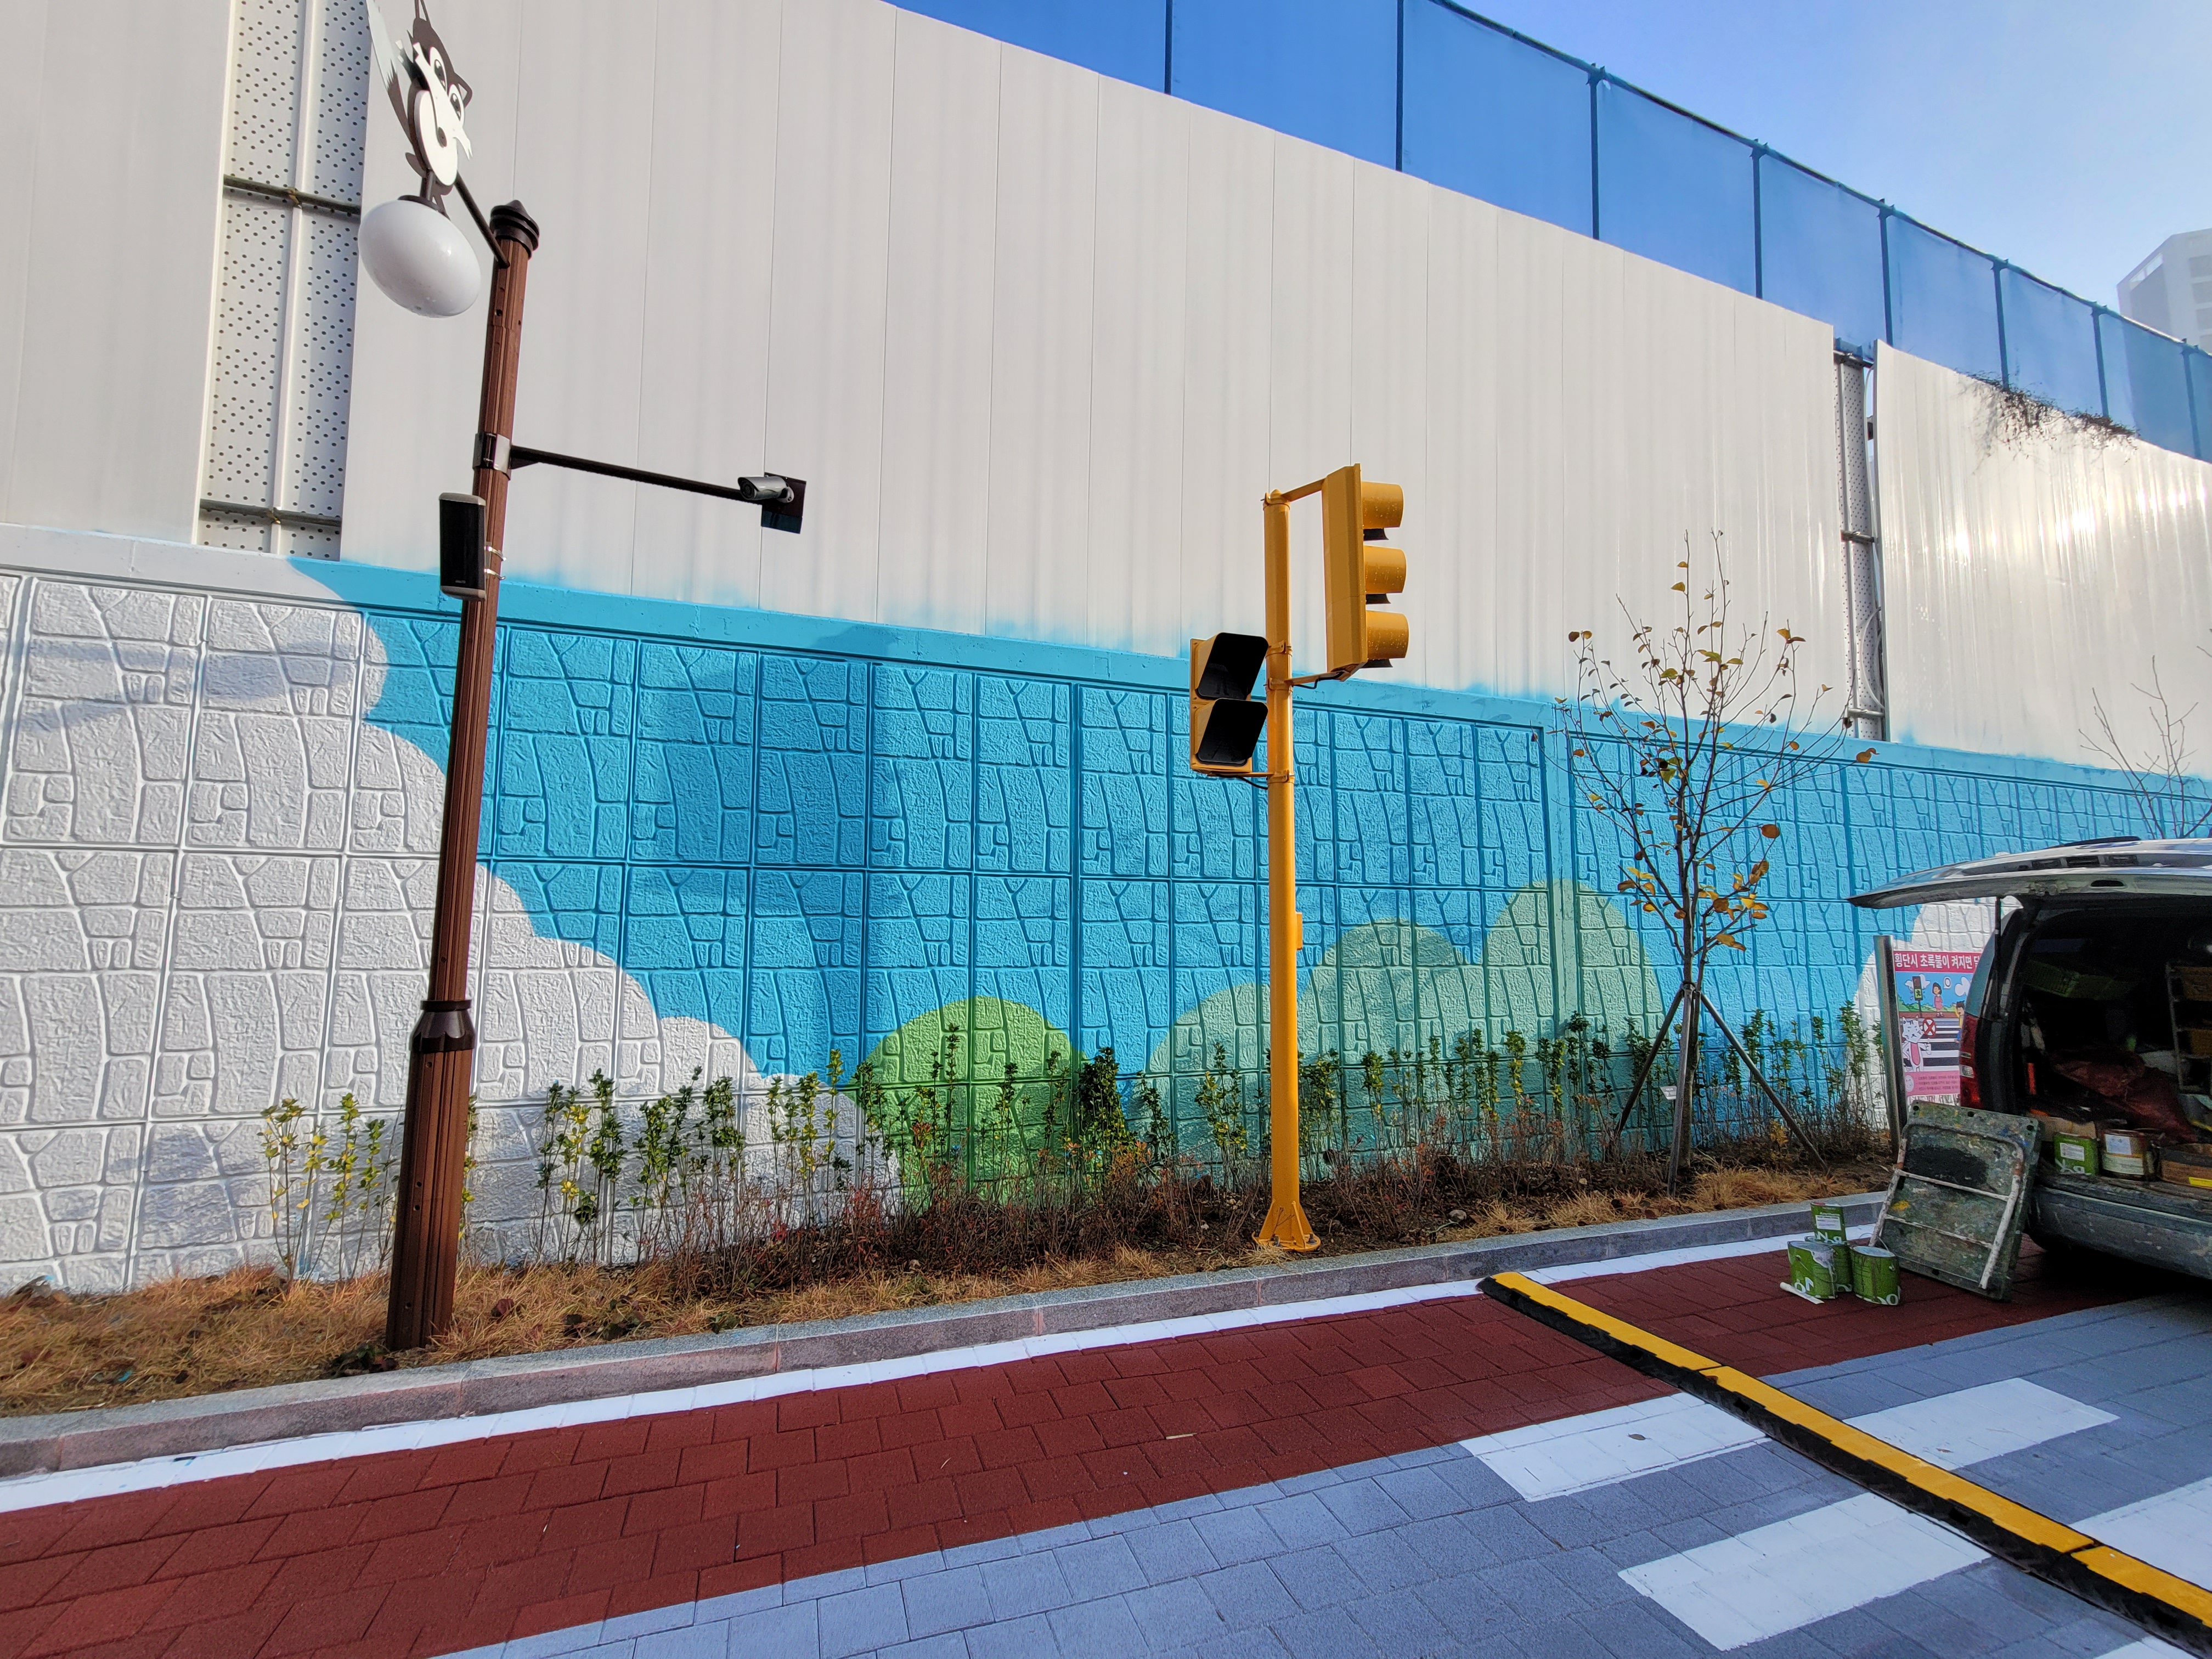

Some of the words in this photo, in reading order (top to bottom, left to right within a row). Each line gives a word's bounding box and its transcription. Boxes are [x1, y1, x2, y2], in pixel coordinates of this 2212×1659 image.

[1894, 953, 1918, 968] 횡단시
[1920, 954, 1950, 969] 초록불이
[1951, 955, 1973, 969] 켜지면
